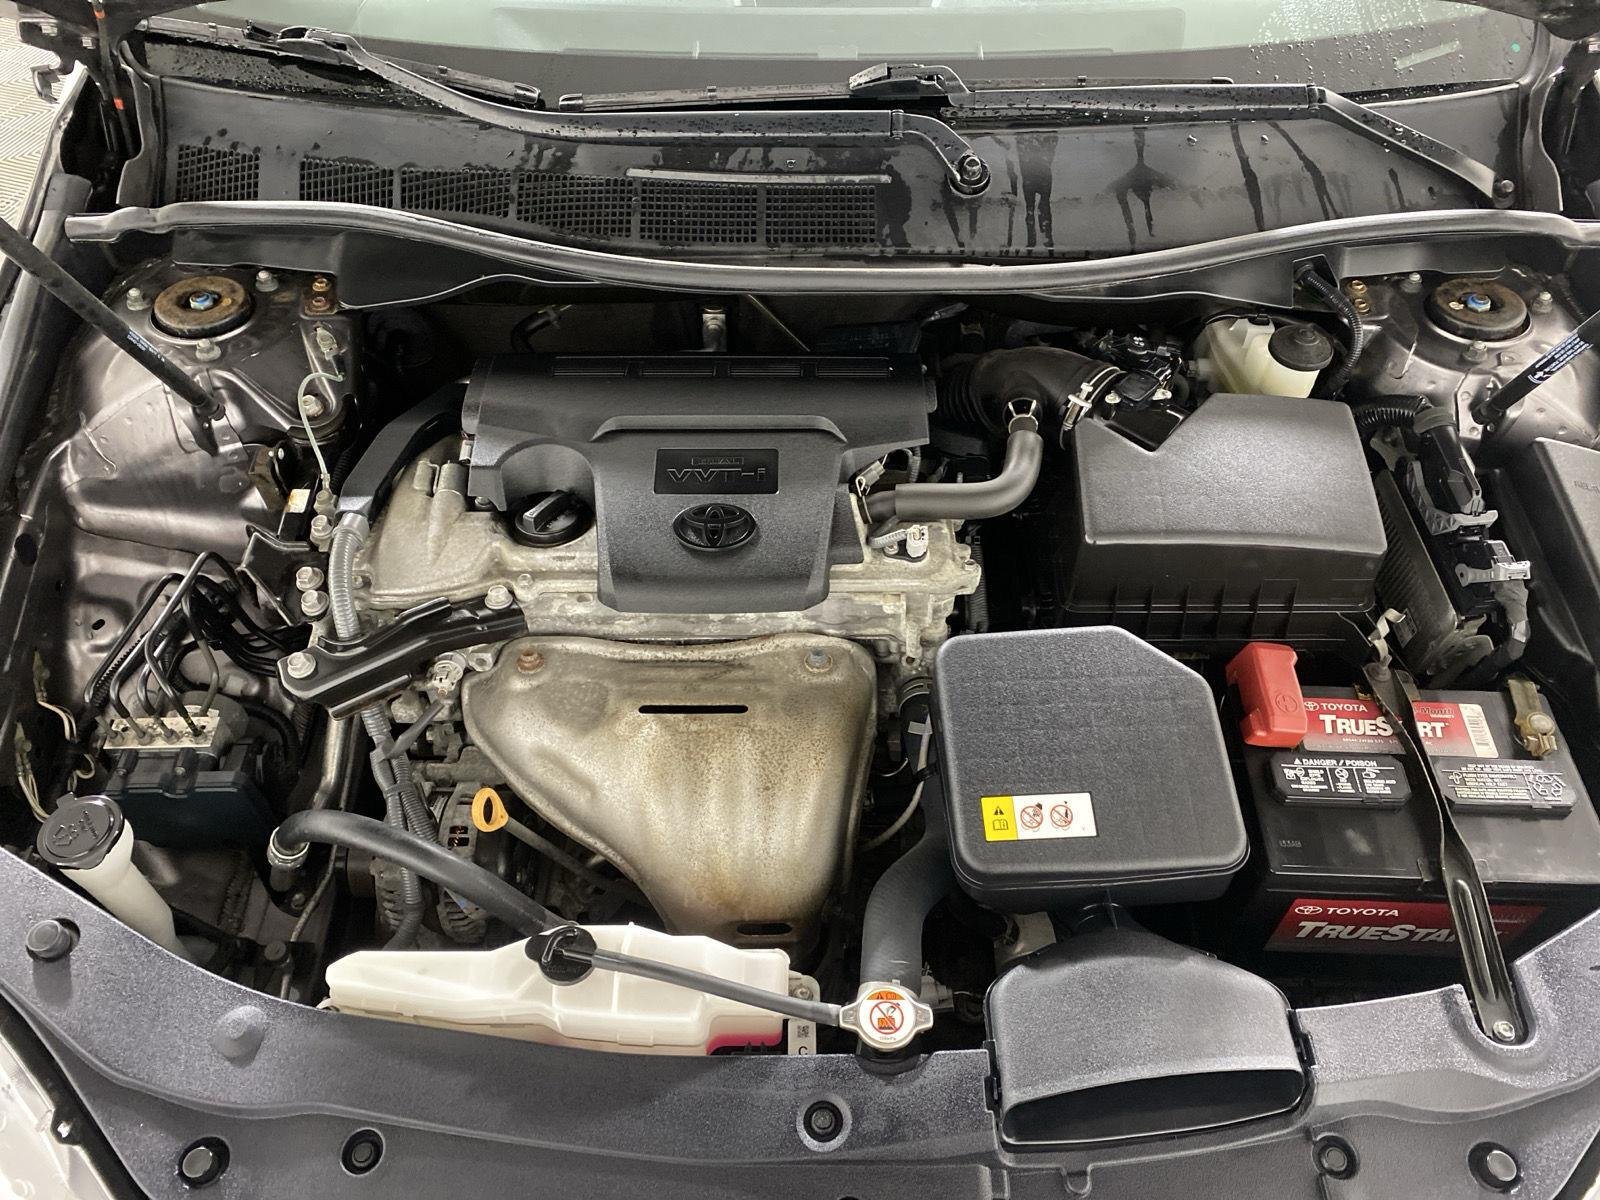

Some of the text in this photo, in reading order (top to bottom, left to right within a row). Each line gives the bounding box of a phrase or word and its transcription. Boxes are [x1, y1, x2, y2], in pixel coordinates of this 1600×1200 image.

[666, 467, 766, 482] VVT-i
[1320, 702, 1368, 712] TOYOTA
[1319, 714, 1446, 738] TRUESRT
[1302, 758, 1338, 766] DANGER
[1345, 759, 1378, 767] POISON
[1326, 907, 1399, 917] TOYOTA
[1295, 921, 1456, 943] TRUESTA
